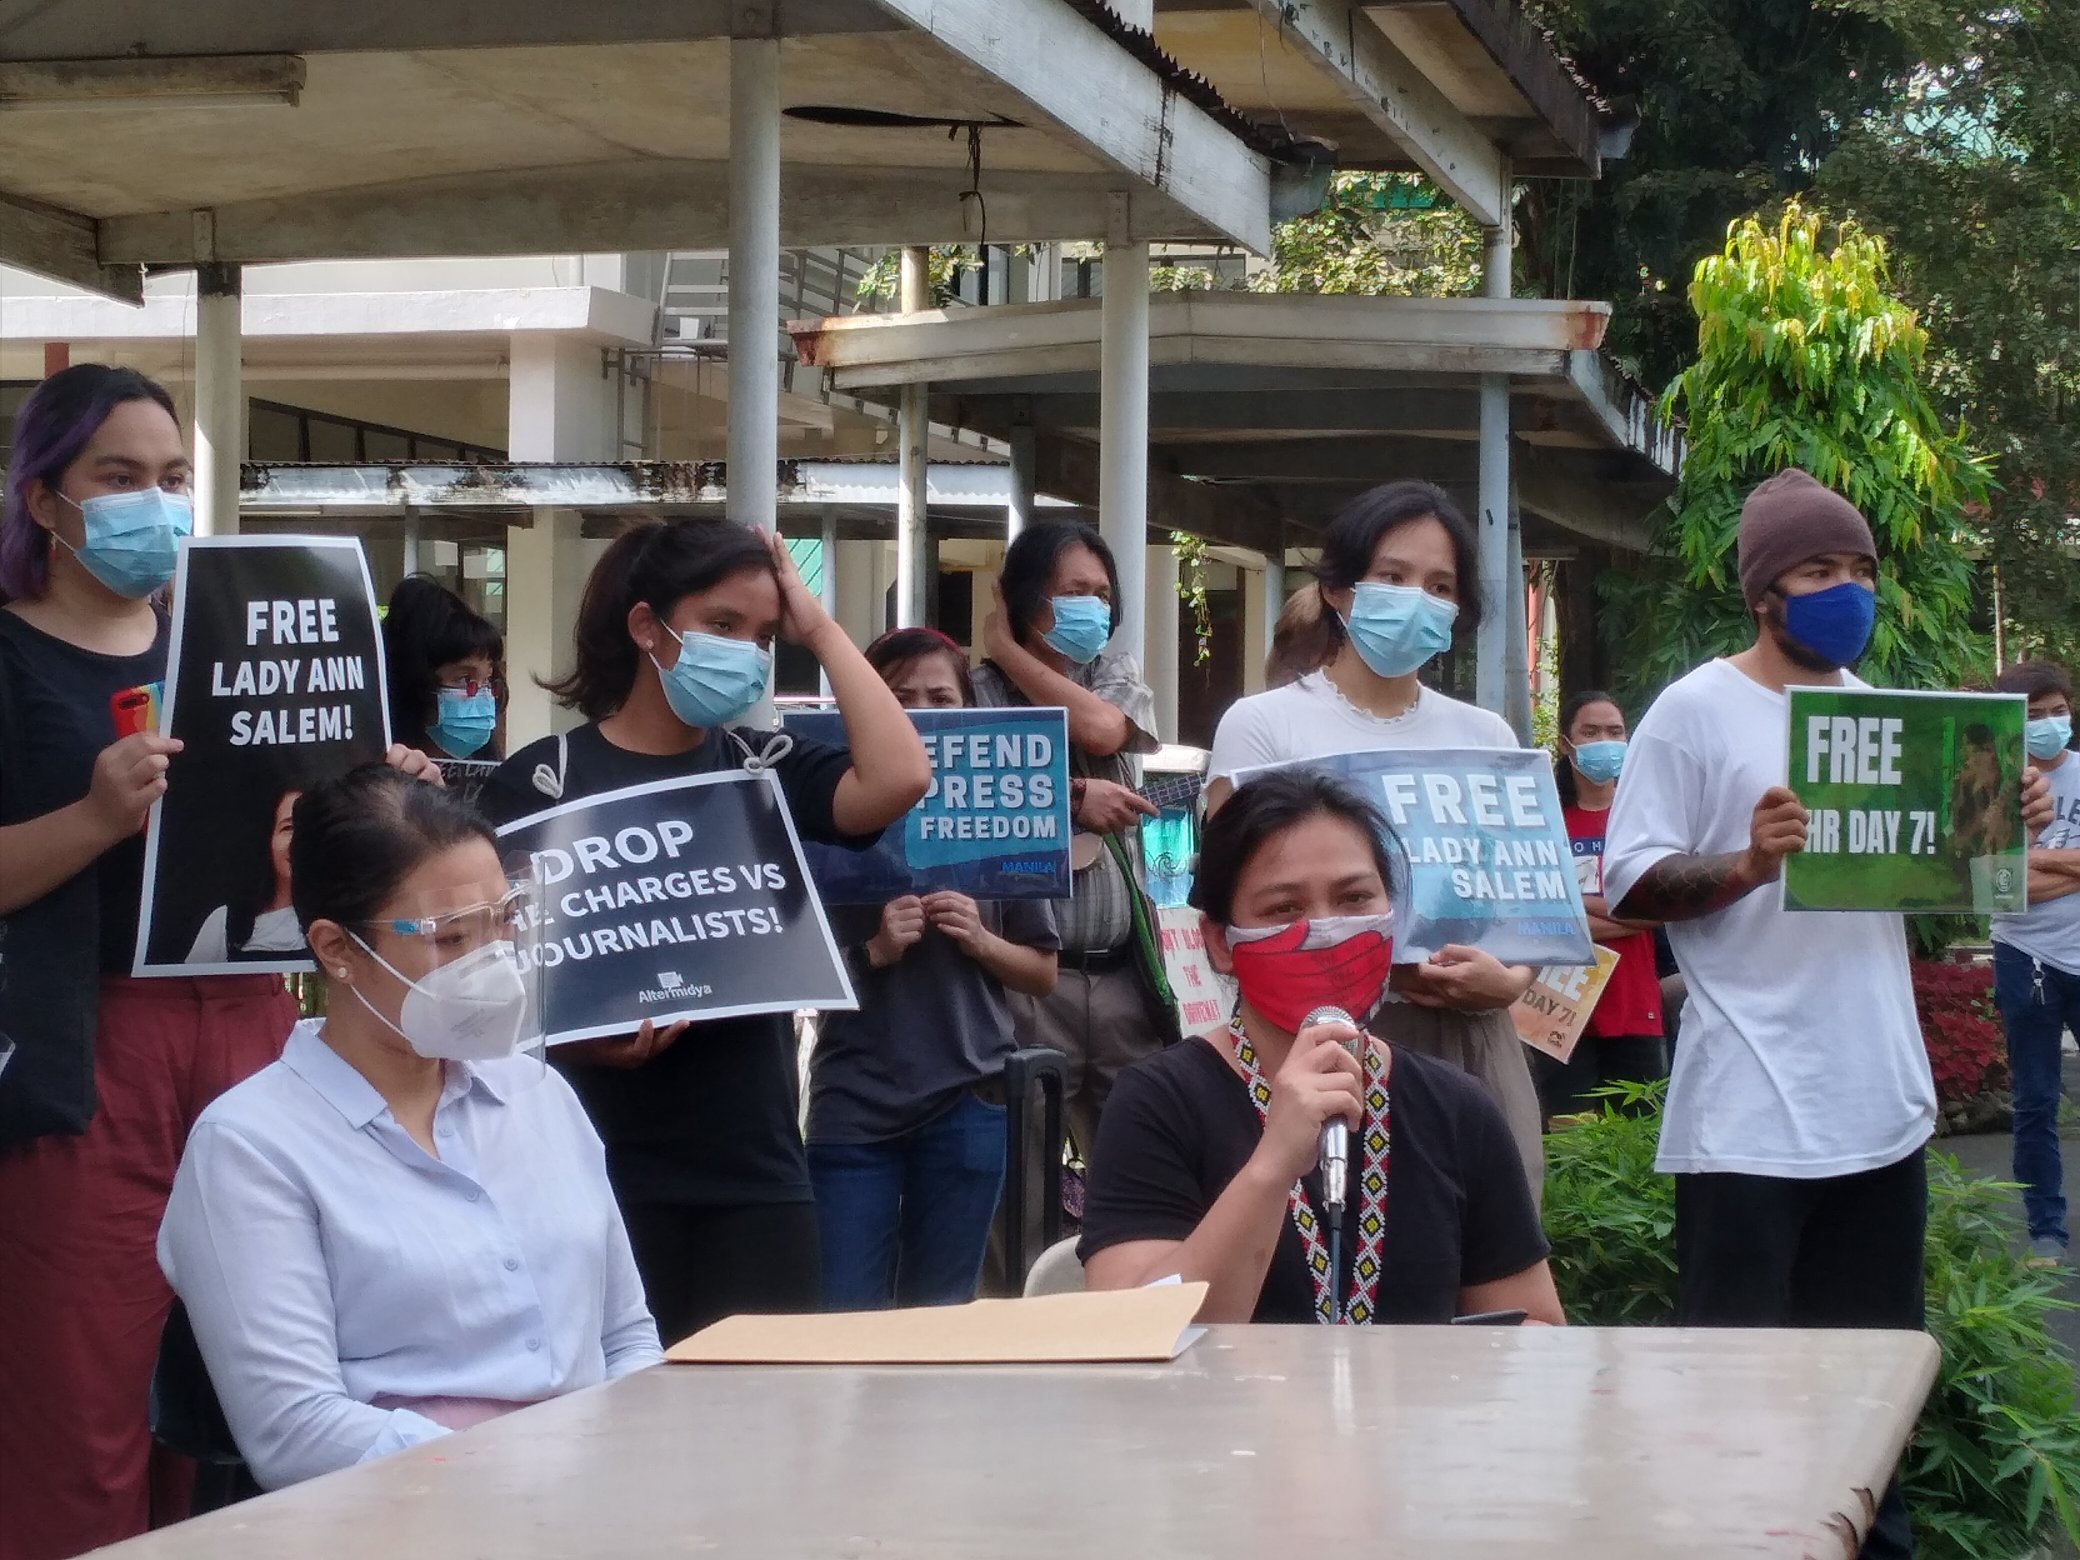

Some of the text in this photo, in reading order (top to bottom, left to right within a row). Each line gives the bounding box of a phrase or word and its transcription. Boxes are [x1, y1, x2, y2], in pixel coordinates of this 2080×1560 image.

[246, 598, 340, 645] FREE
[212, 656, 365, 696] LADY ANN
[229, 704, 353, 746] SALEM!
[920, 734, 1053, 768] EFEND
[1807, 716, 1903, 784] FREE
[915, 774, 1053, 809] PRESS
[1381, 774, 1546, 826] FREE
[920, 815, 1056, 840] FREEDOM
[1849, 809, 1901, 854] DAY
[1909, 811, 1935, 855] 7!
[530, 820, 693, 887] DROP
[1002, 861, 1055, 874] MANILA
[1401, 837, 1559, 866] LADY ANN
[560, 867, 737, 917] CHARGES
[738, 863, 787, 890] VS
[1452, 868, 1566, 900] SALEM
[515, 907, 784, 975] JOURNALISTS!
[638, 984, 712, 1003] Altermidya
[1522, 988, 1559, 1016] DAY
[1536, 965, 1589, 1002] EE
